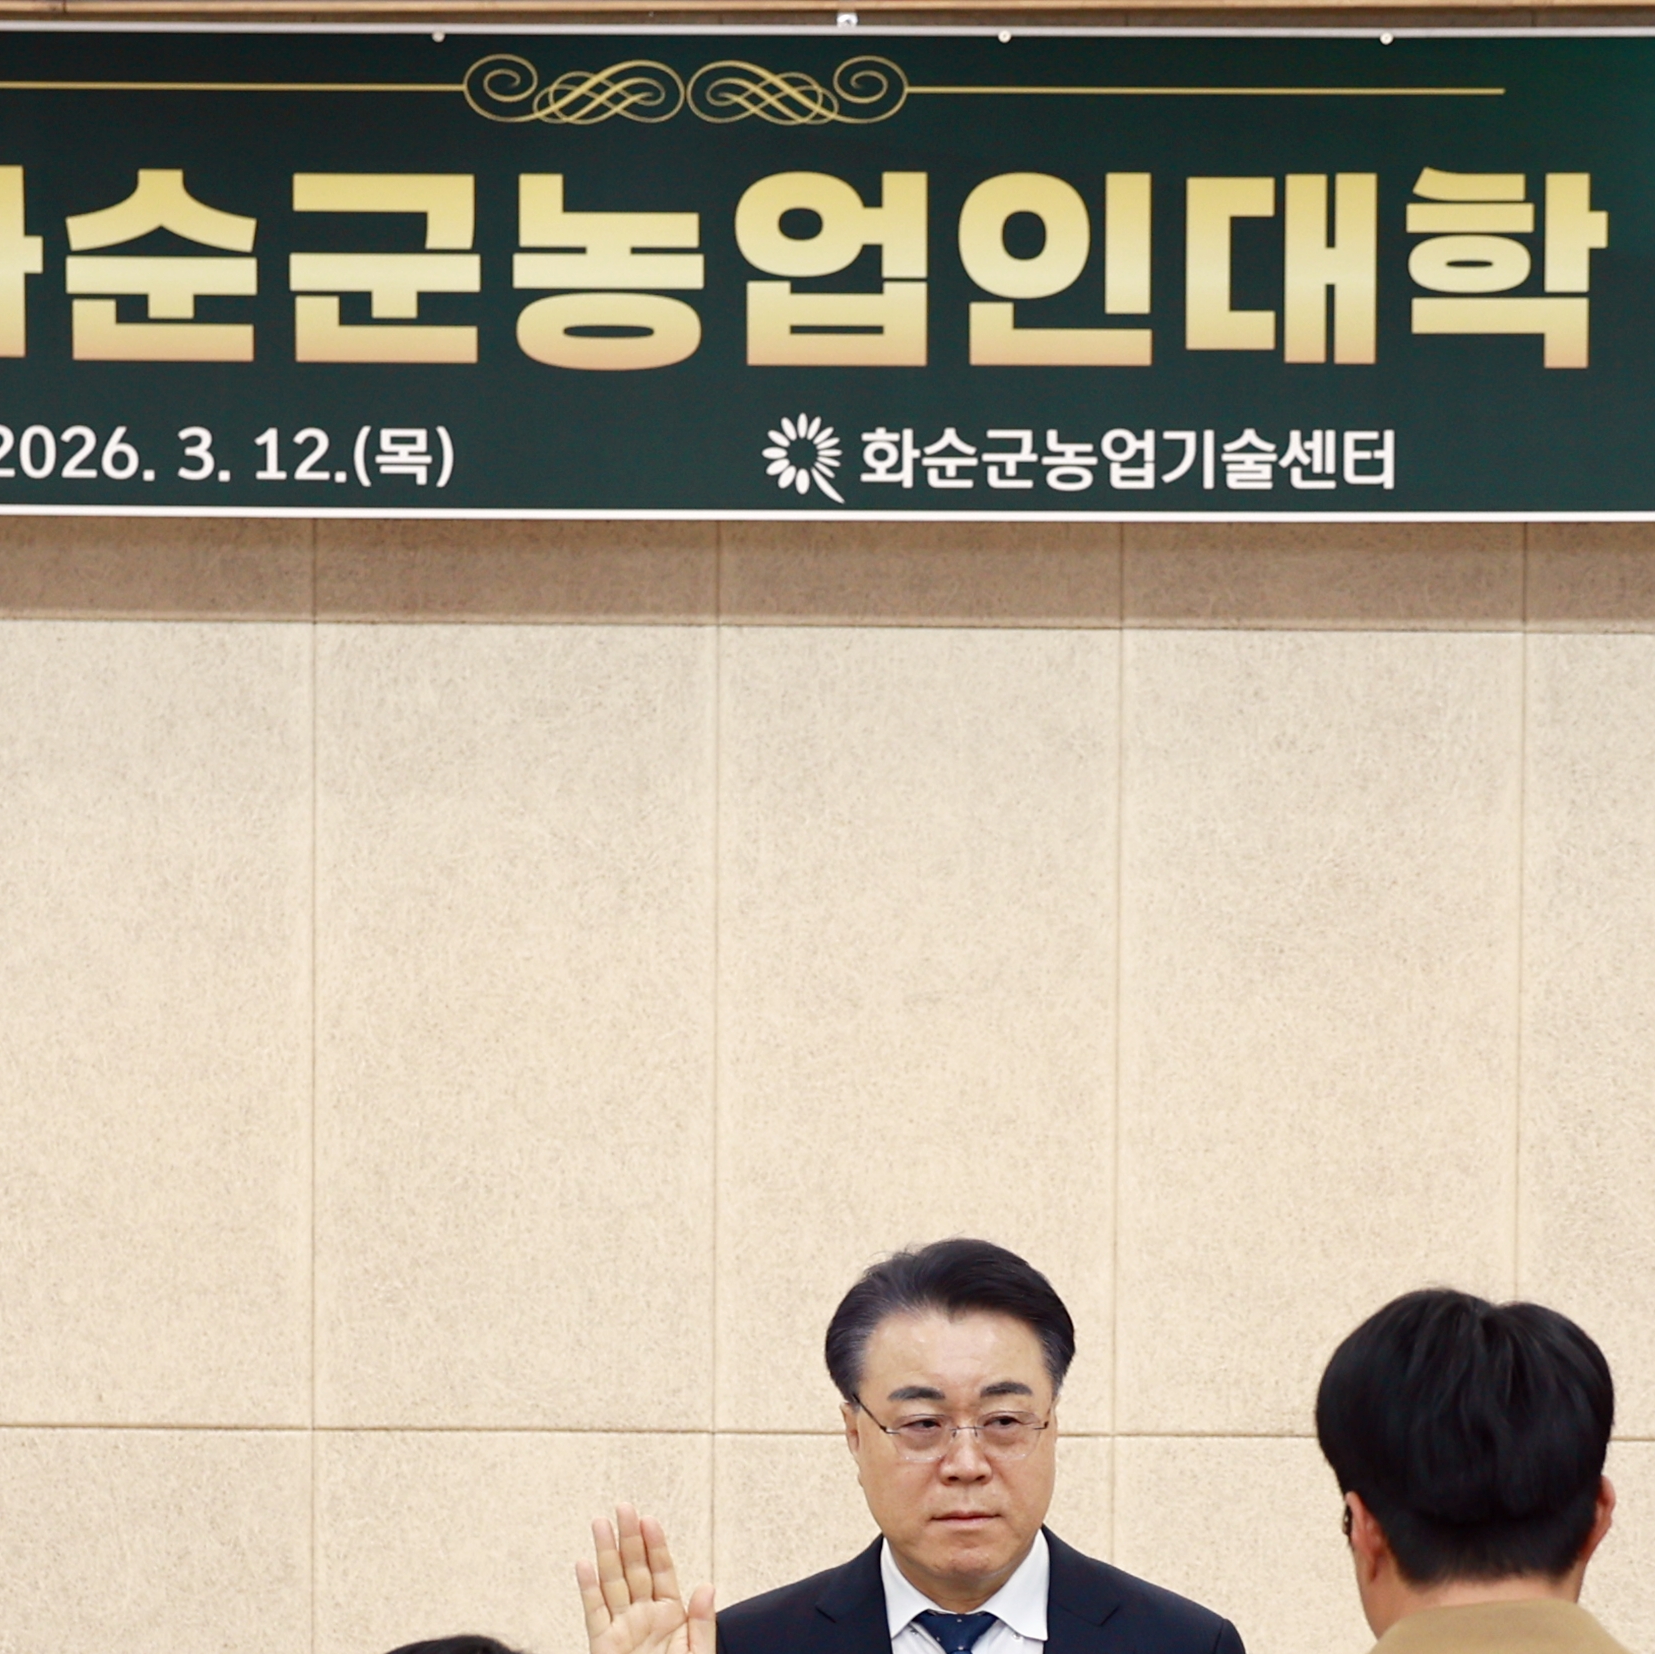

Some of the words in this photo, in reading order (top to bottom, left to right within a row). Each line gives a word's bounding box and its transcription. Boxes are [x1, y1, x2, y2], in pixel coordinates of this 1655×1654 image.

[177, 426, 231, 482] 3.
[254, 425, 454, 488] 12.(목)
[860, 426, 1395, 492] 화순군농업기술센터
